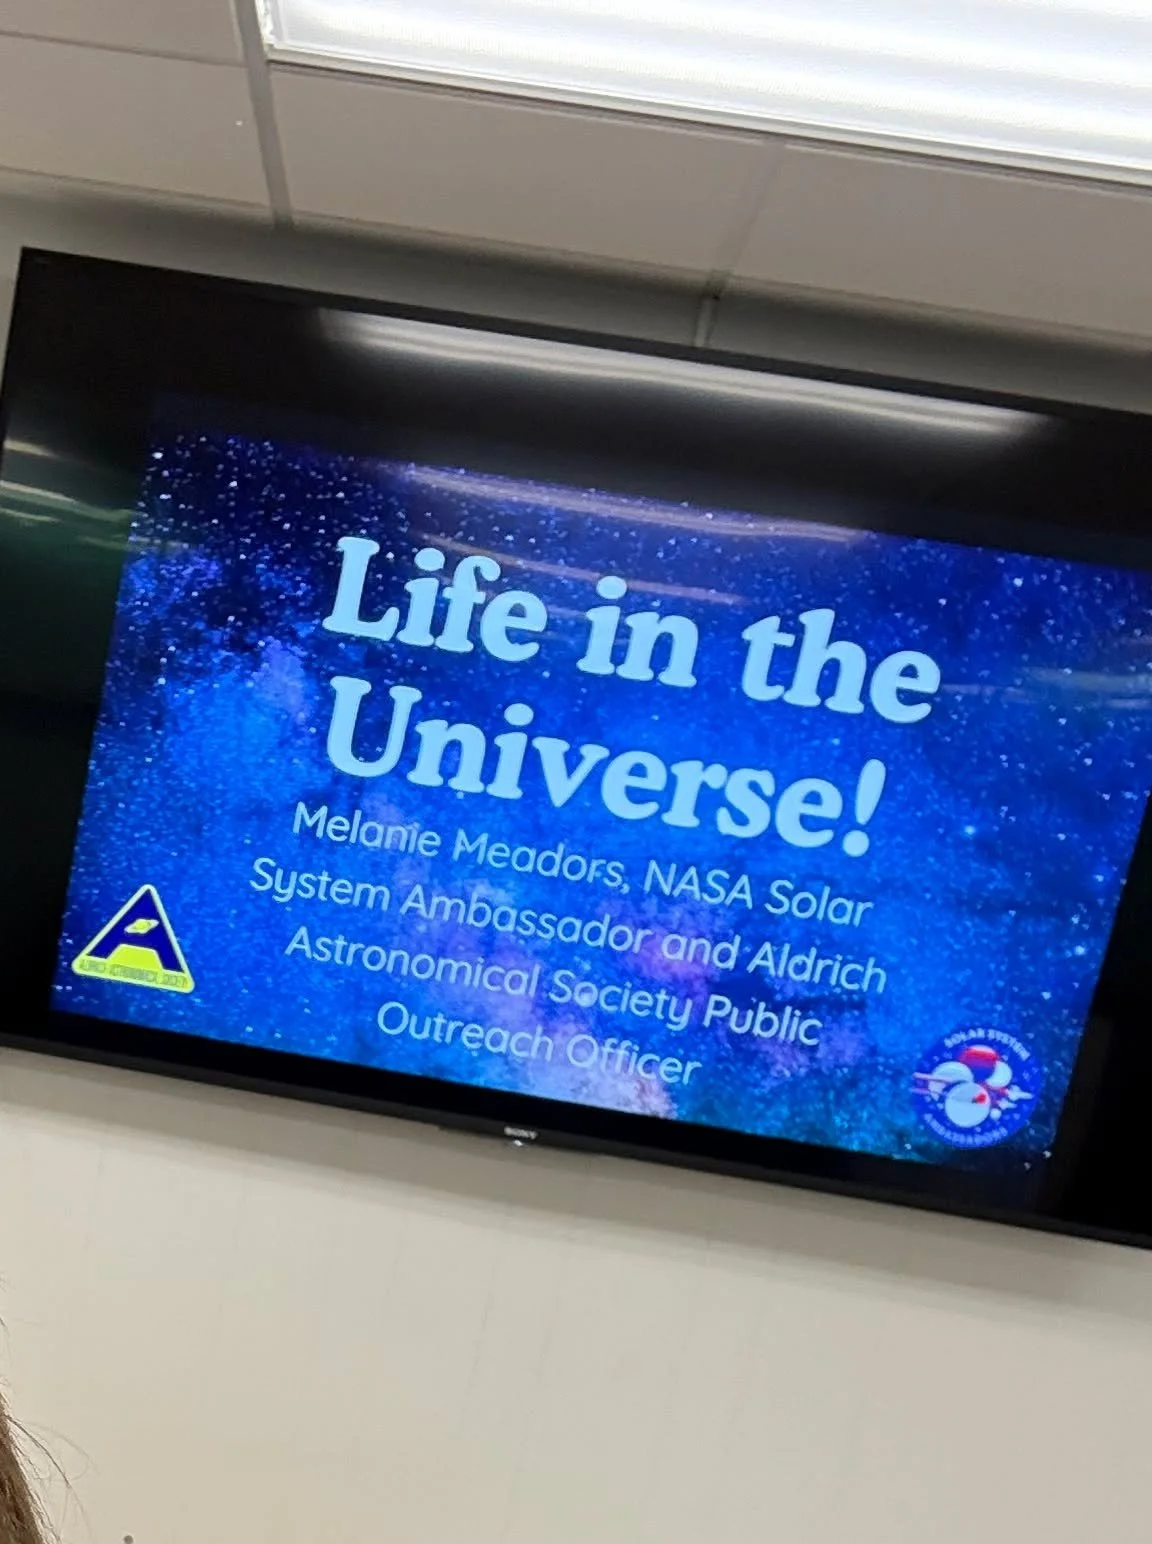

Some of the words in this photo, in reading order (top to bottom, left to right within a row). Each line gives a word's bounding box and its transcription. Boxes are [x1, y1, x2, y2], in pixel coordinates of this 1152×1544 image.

[322, 536, 547, 662] Life
[577, 576, 699, 687] in
[740, 608, 941, 724] the
[327, 677, 887, 857] Universe!
[250, 857, 390, 911] System
[401, 884, 652, 953] Ambassador
[661, 930, 741, 972] and
[748, 940, 887, 994] Aldrich
[292, 802, 440, 857] Melanie
[453, 831, 631, 894] Meadors,
[645, 859, 754, 909] NASA
[764, 879, 874, 928] Solar
[285, 926, 539, 996] Astronomical
[548, 969, 692, 1031] Society
[702, 995, 823, 1047] Public
[377, 1001, 552, 1061] Outreach
[566, 1033, 702, 1086] Officer
